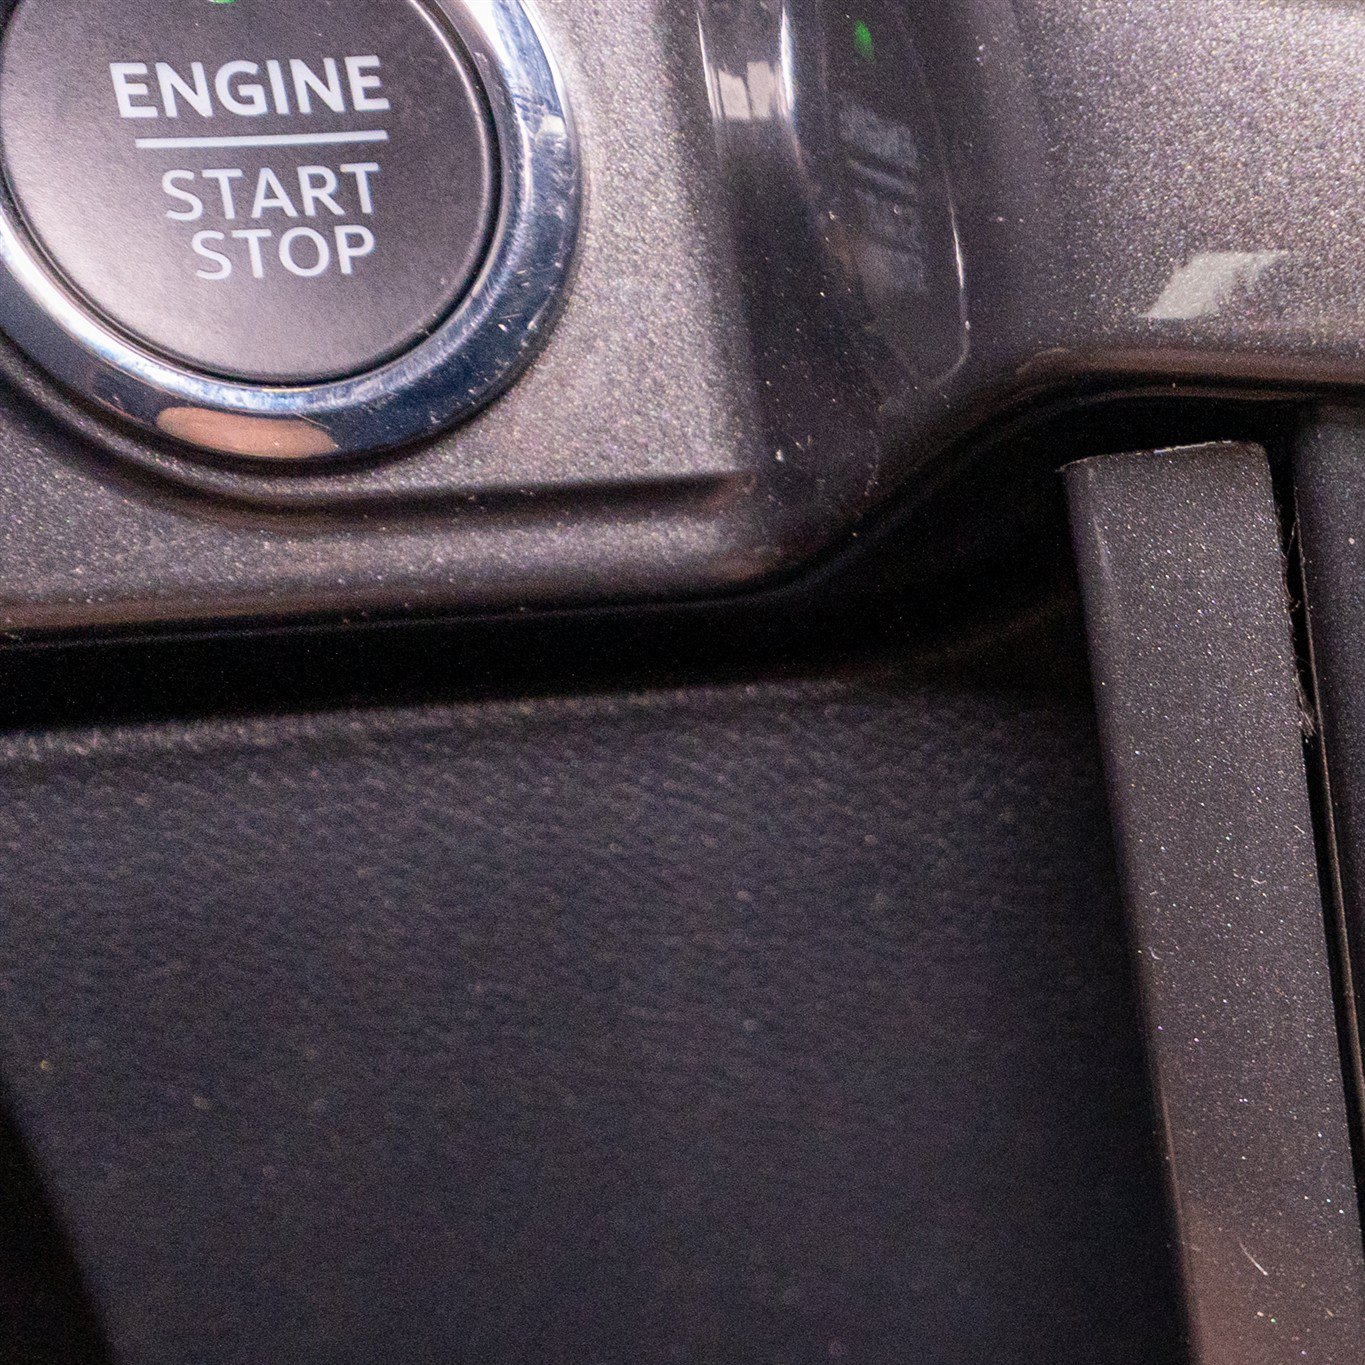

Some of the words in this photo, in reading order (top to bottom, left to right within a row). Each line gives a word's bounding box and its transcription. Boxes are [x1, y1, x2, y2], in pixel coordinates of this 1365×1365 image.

[109, 56, 390, 119] ENGINE
[161, 163, 379, 221] START
[191, 226, 375, 281] STOP
